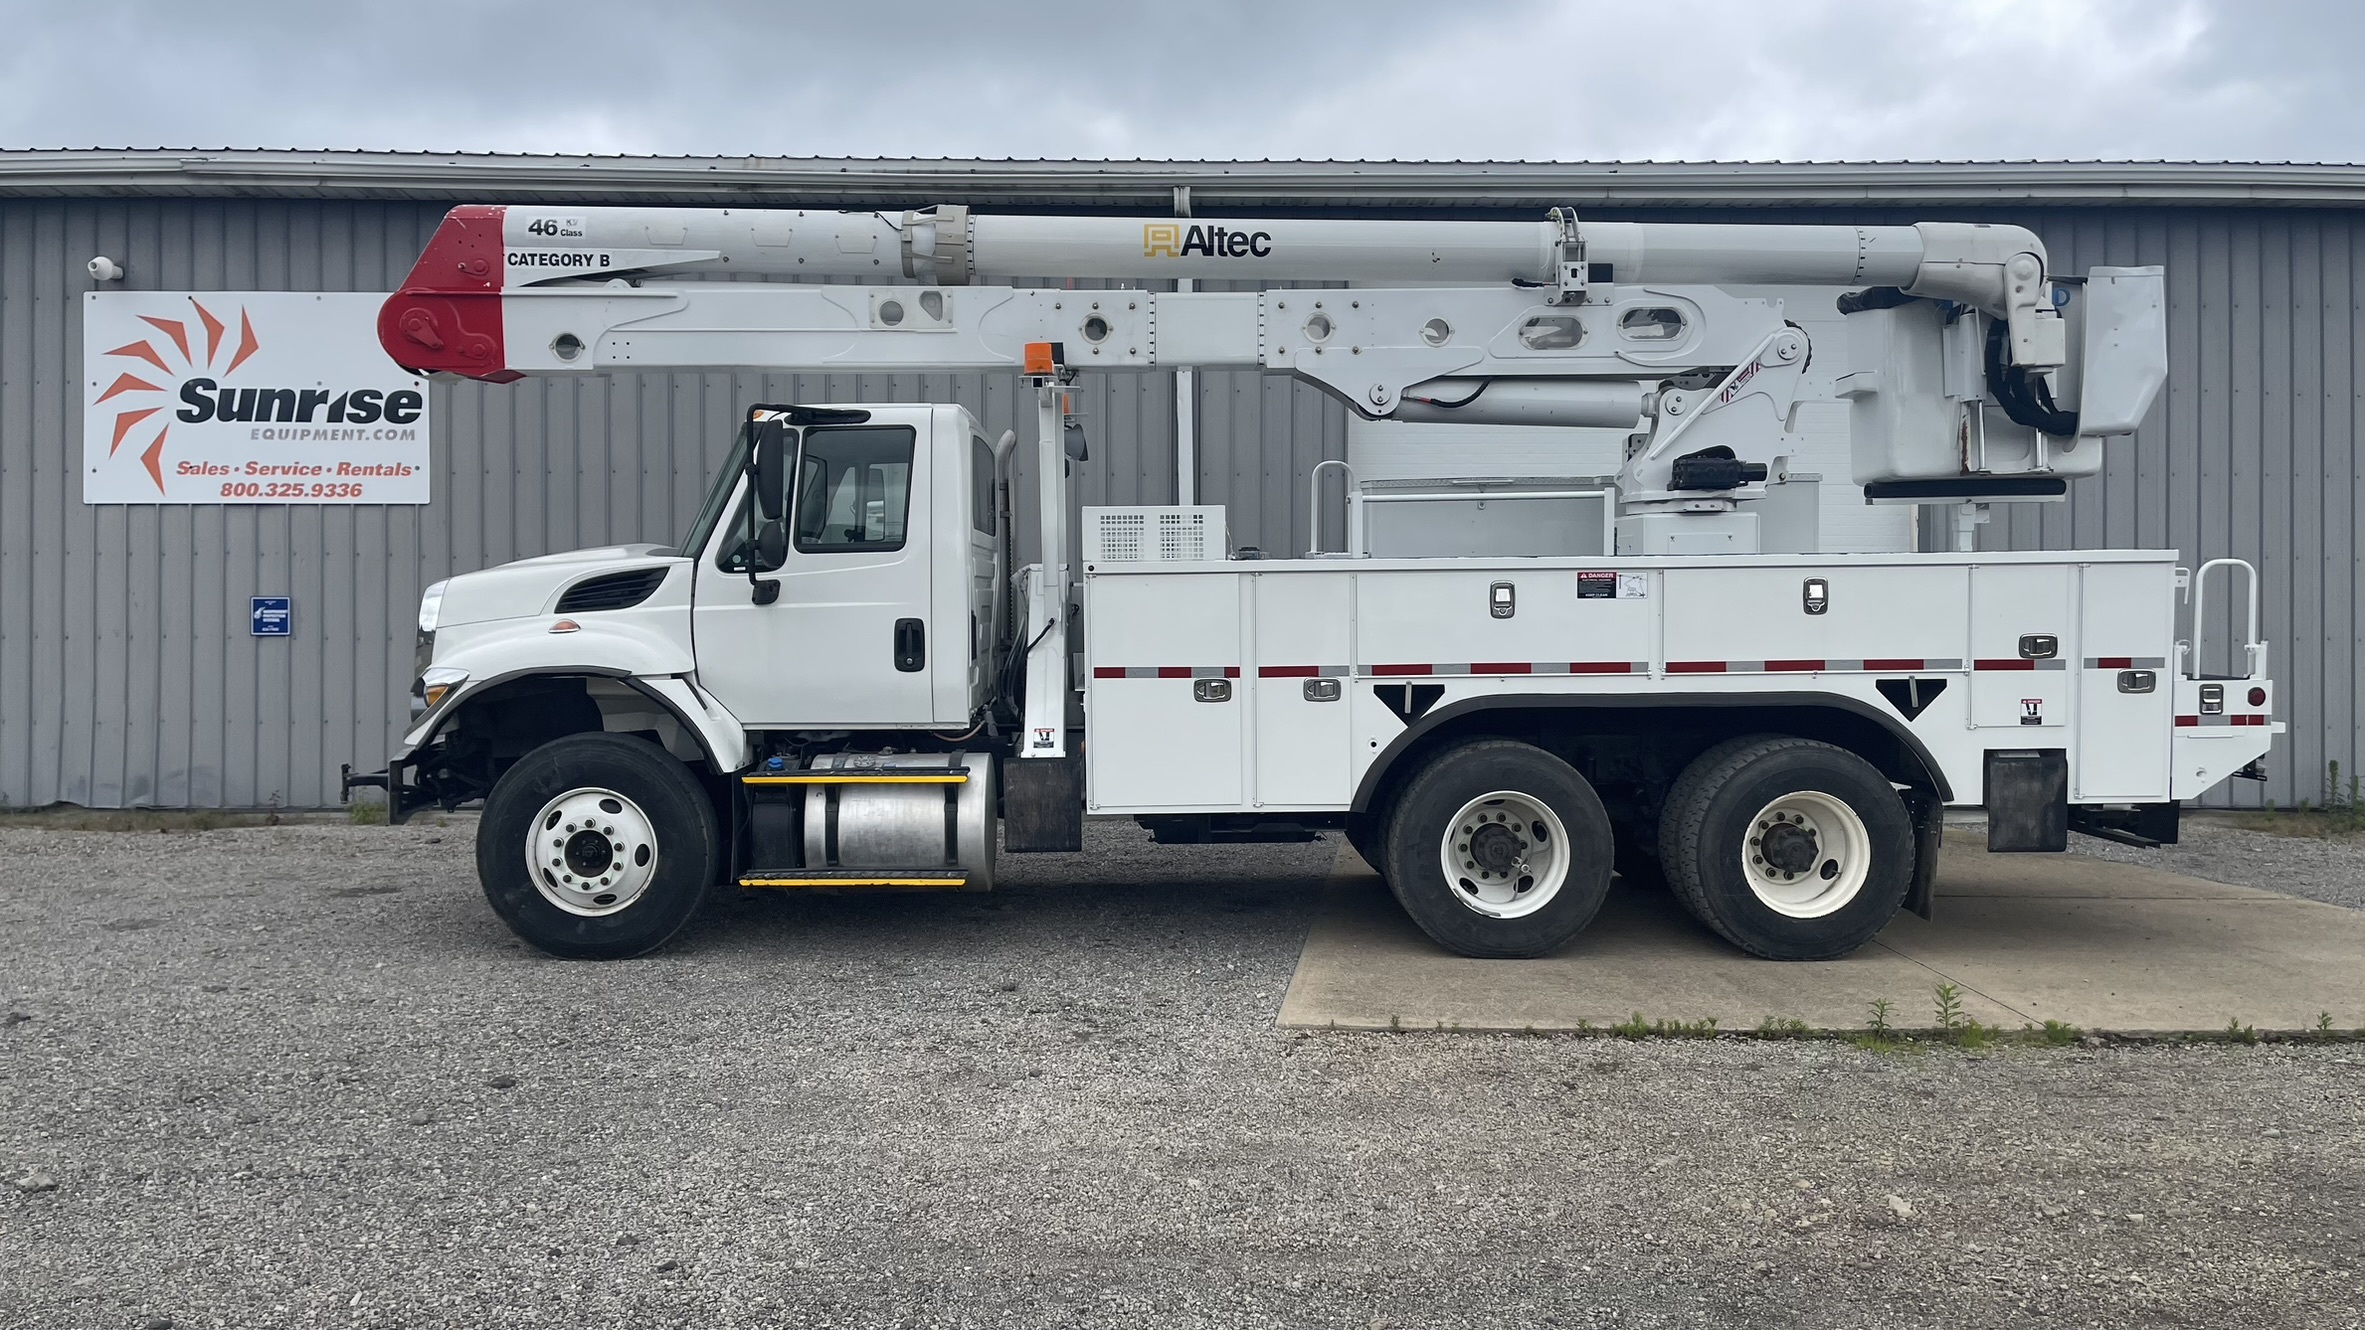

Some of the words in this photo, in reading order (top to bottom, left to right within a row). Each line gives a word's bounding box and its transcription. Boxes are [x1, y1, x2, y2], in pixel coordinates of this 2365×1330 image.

[528, 219, 558, 236] 46
[560, 228, 583, 237] Class
[1180, 225, 1272, 257] Altec
[507, 252, 594, 267] CATEGORY
[600, 254, 611, 267] B
[176, 377, 423, 424] Sunrise
[250, 428, 417, 441] EQUIPMENT.COM
[176, 461, 230, 476] Sales
[244, 461, 322, 476] Service
[336, 462, 412, 476] Rentals
[220, 482, 363, 498] 800.325.9336
